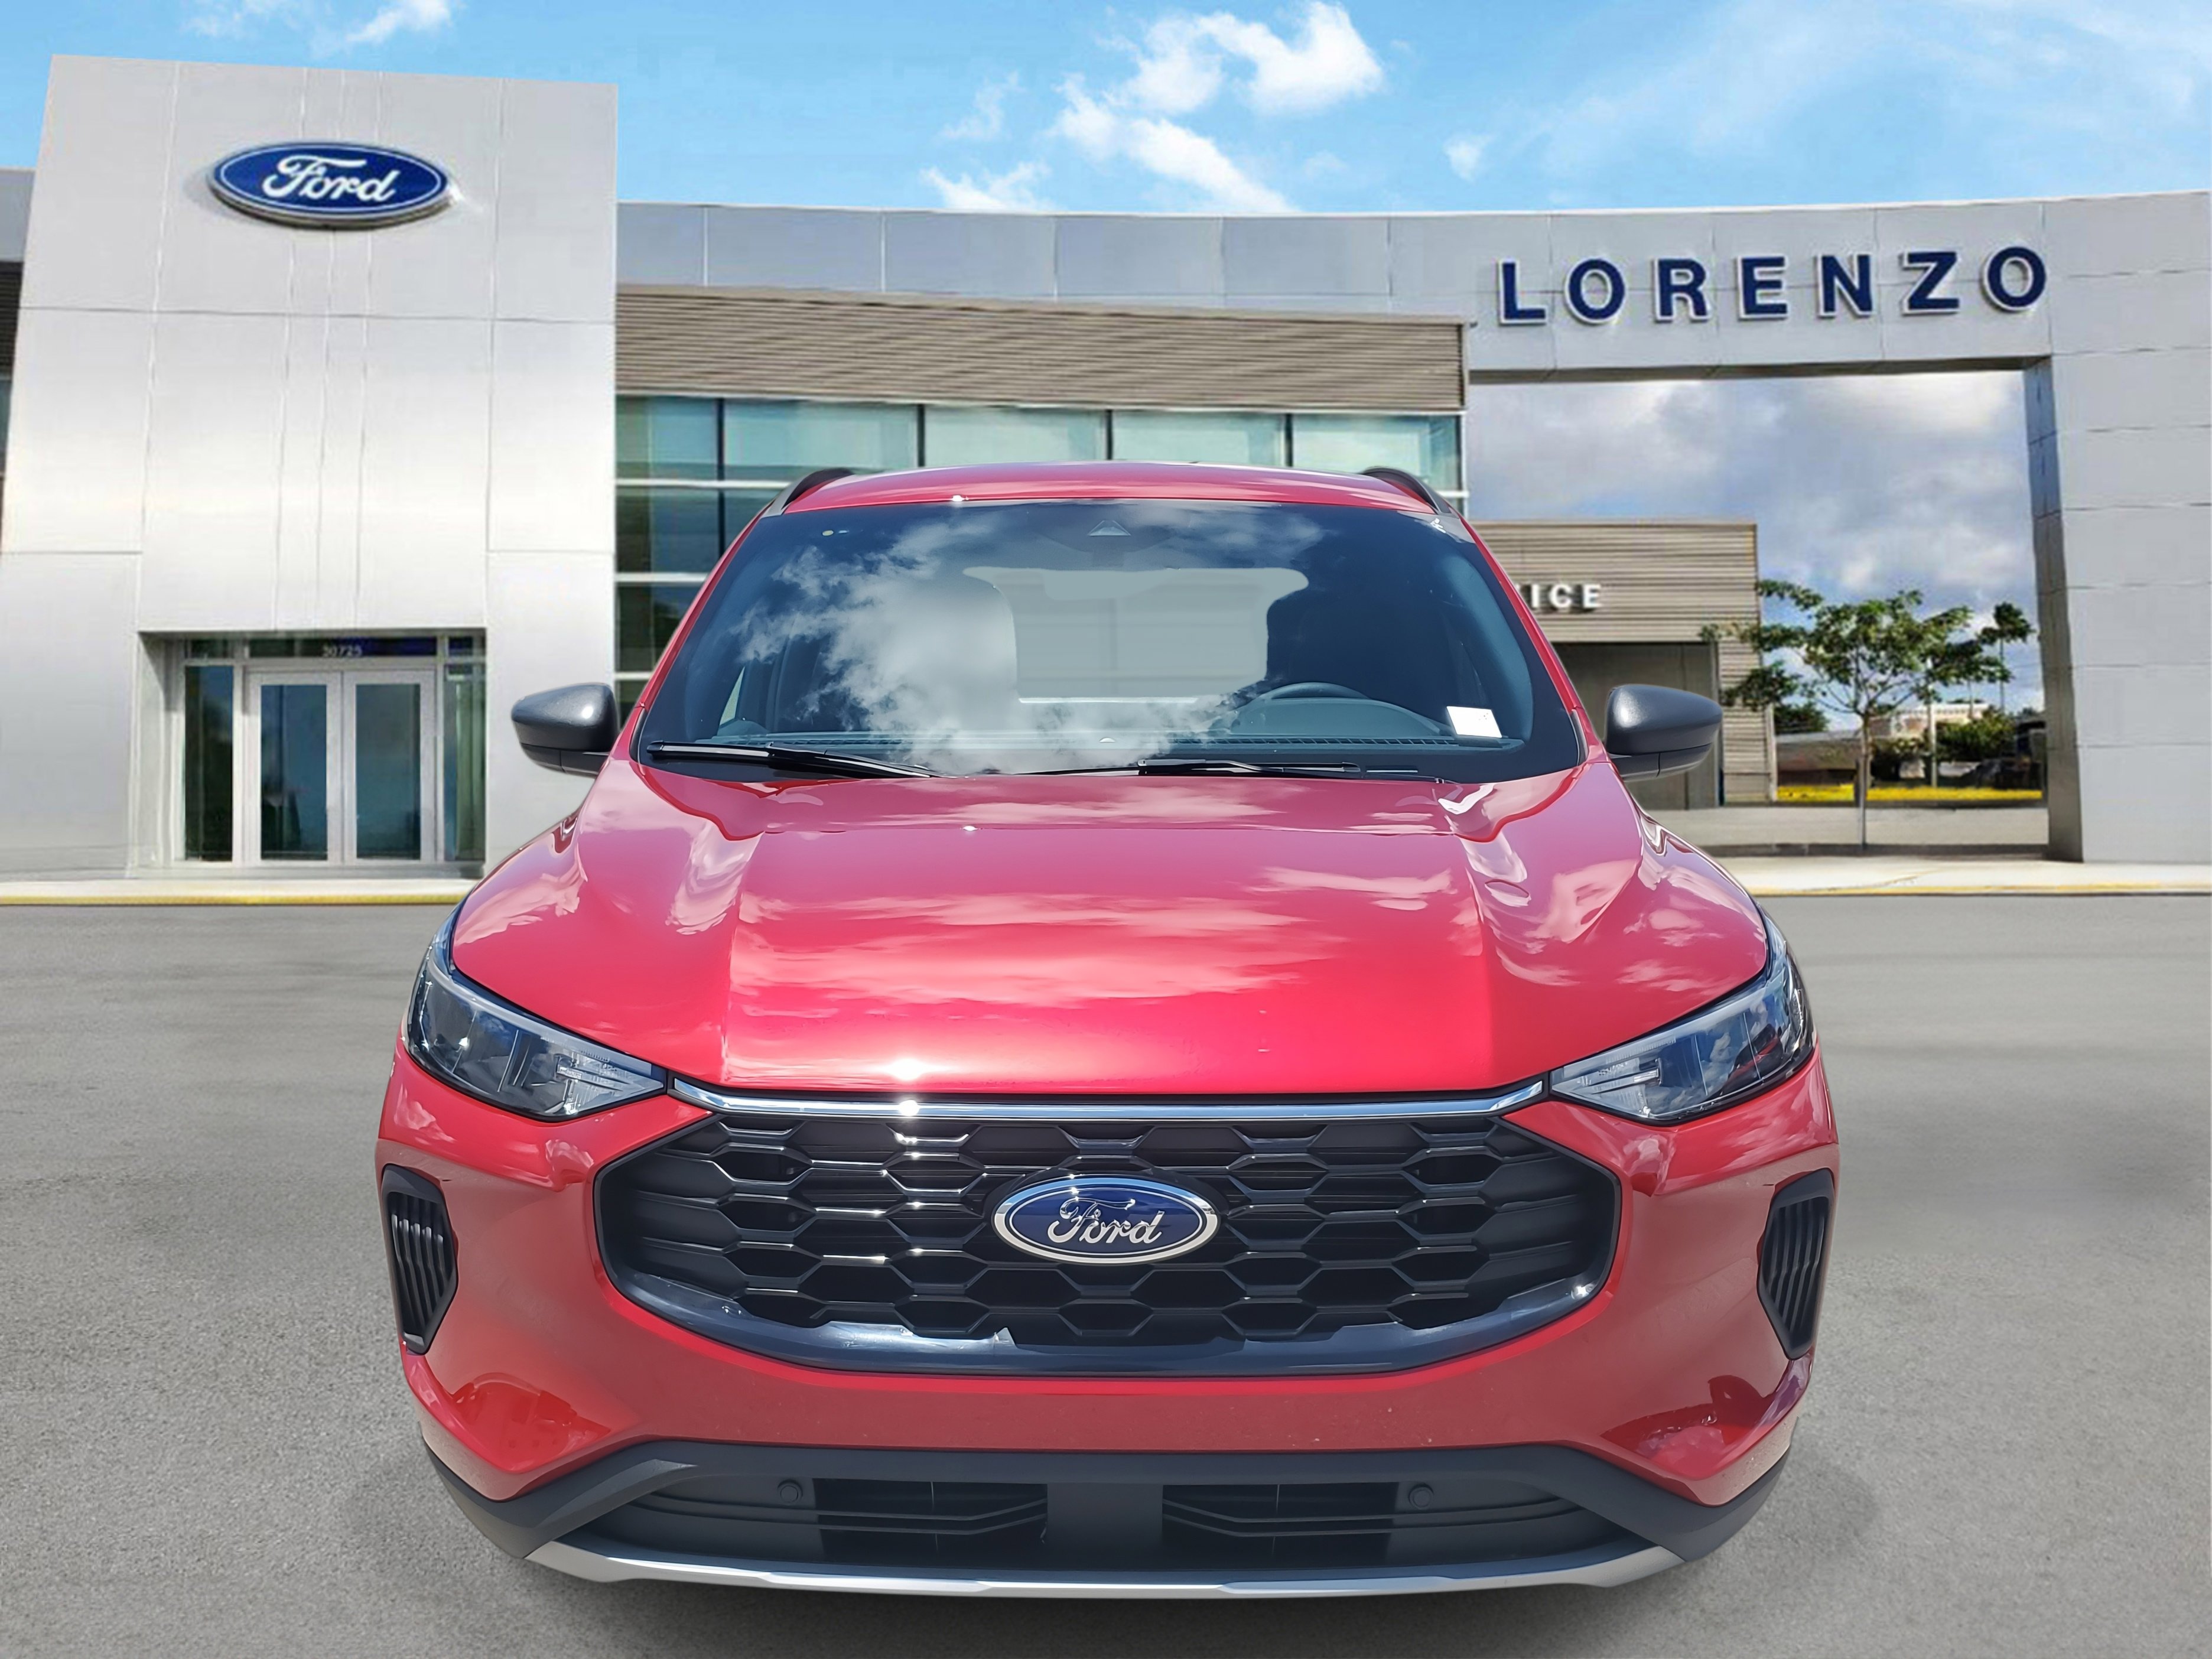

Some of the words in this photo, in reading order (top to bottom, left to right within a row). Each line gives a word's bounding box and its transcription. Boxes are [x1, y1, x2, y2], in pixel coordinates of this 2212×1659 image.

[262, 154, 401, 201] Ford
[1498, 246, 2047, 324] LORENZO
[1515, 583, 1602, 609] ICE
[1047, 1196, 1165, 1244] Ford
